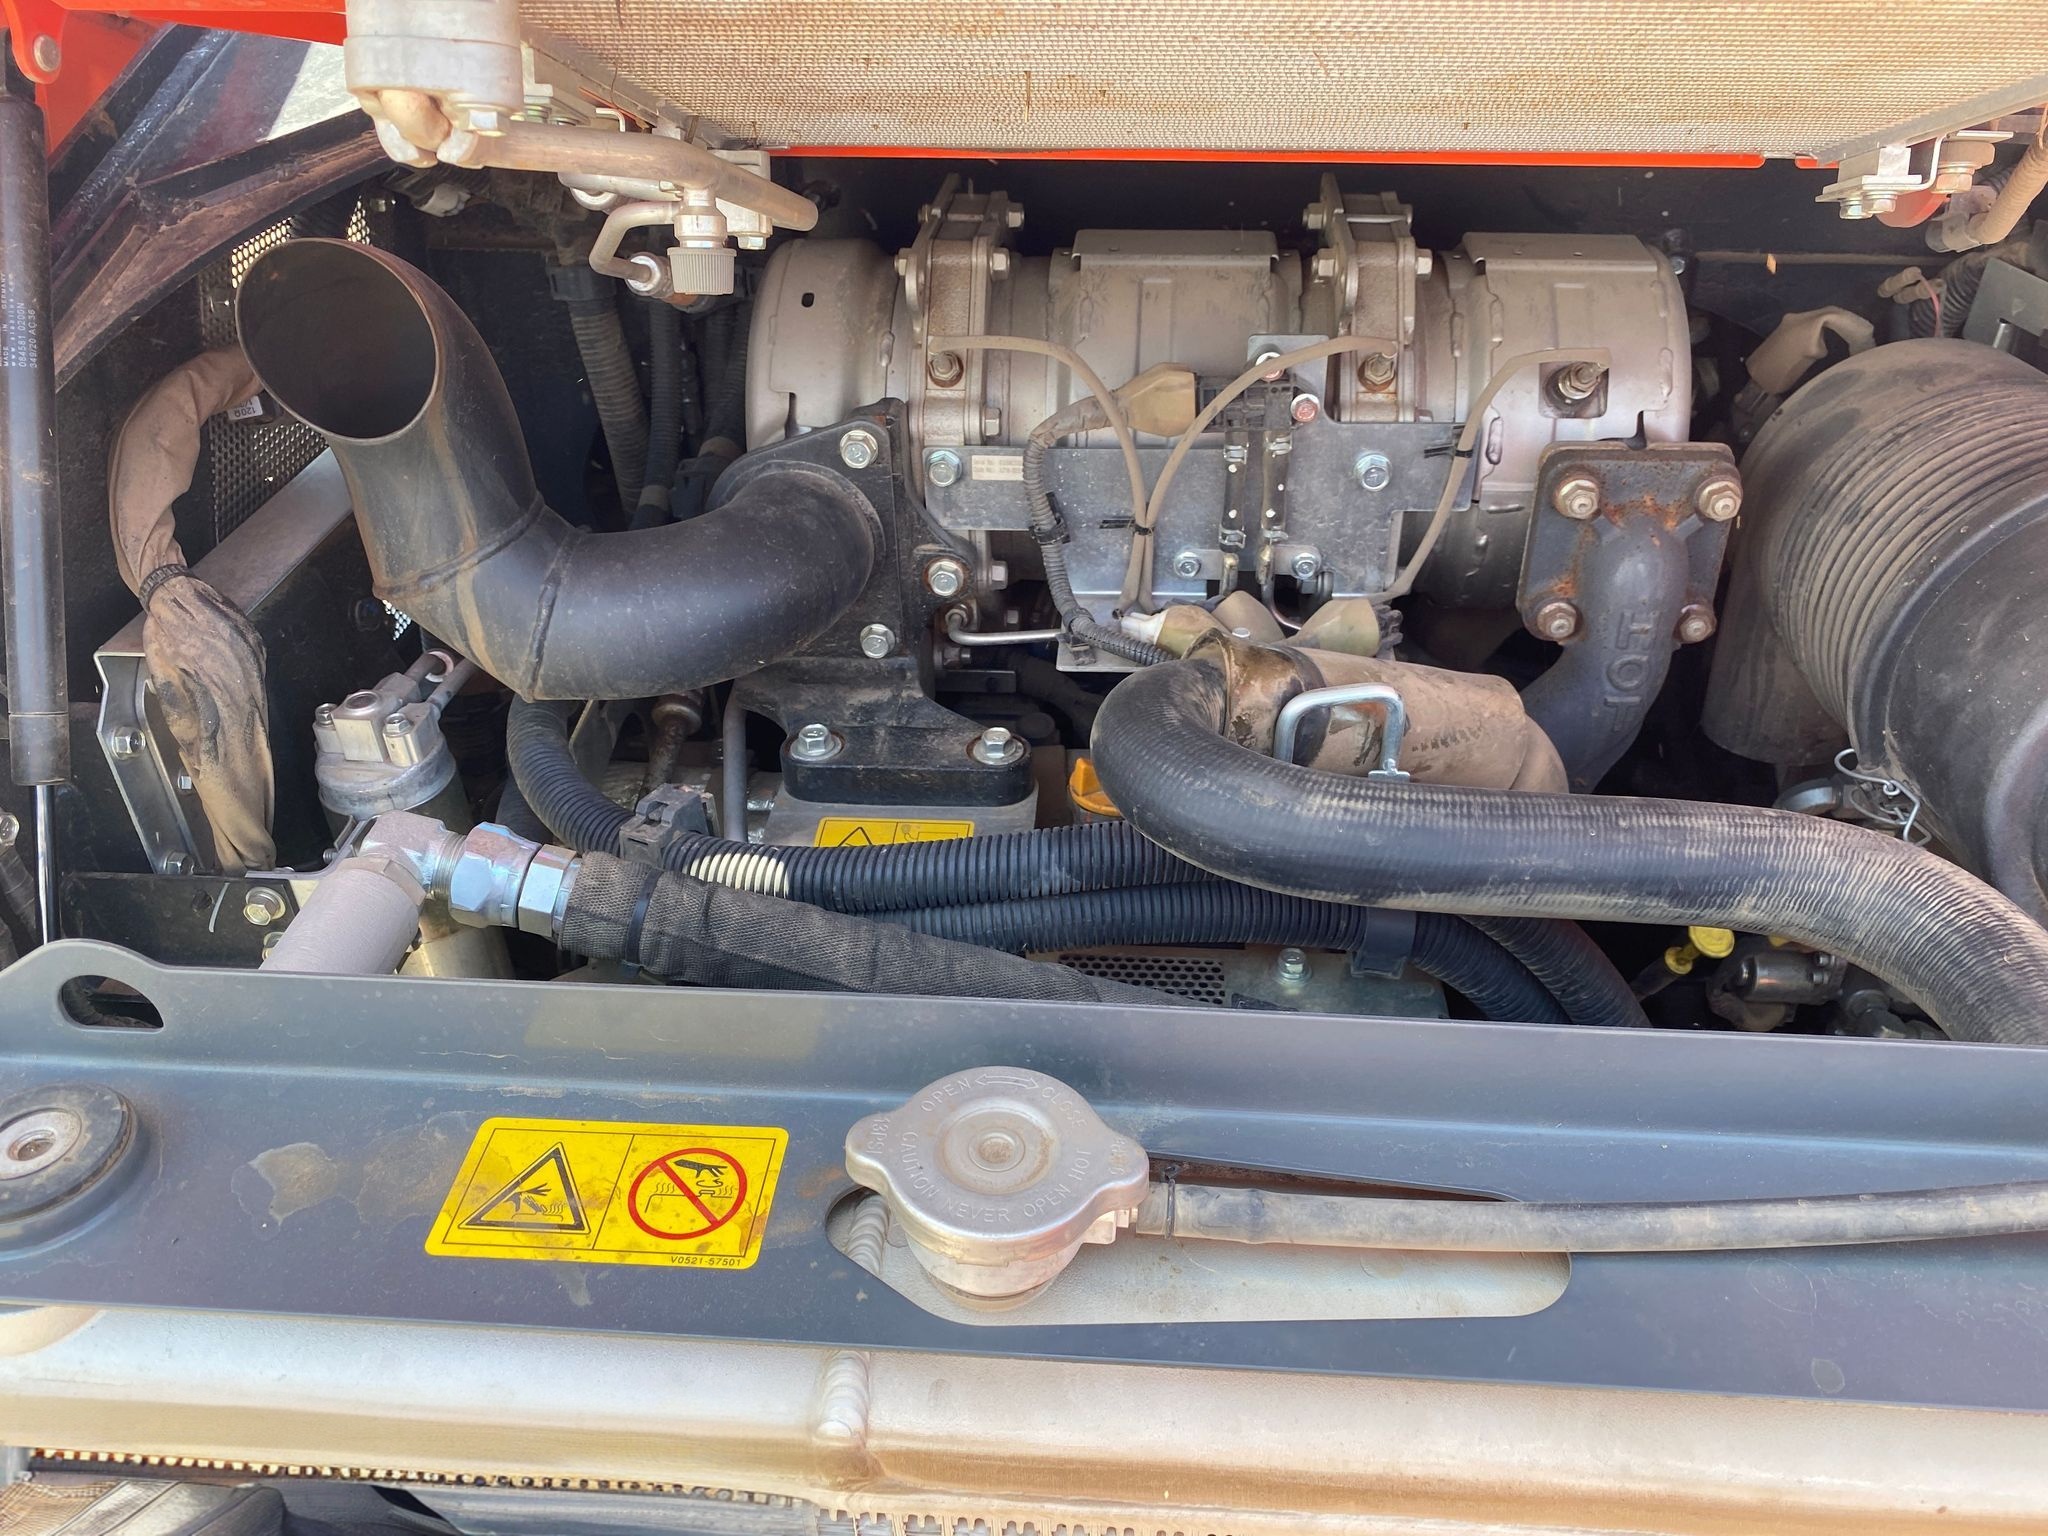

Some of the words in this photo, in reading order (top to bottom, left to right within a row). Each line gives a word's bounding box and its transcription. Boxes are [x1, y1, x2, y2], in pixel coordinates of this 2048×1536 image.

[1603, 608, 1661, 733] HOT
[921, 1079, 971, 1112] OPEN
[1041, 1086, 1088, 1129] CLOSE
[900, 1131, 941, 1198] CAUTION
[945, 1199, 1011, 1222] NEVER
[1023, 1184, 1071, 1218] OPEN
[1069, 1149, 1092, 1182] HOT
[670, 1256, 742, 1267] V0521-57501
